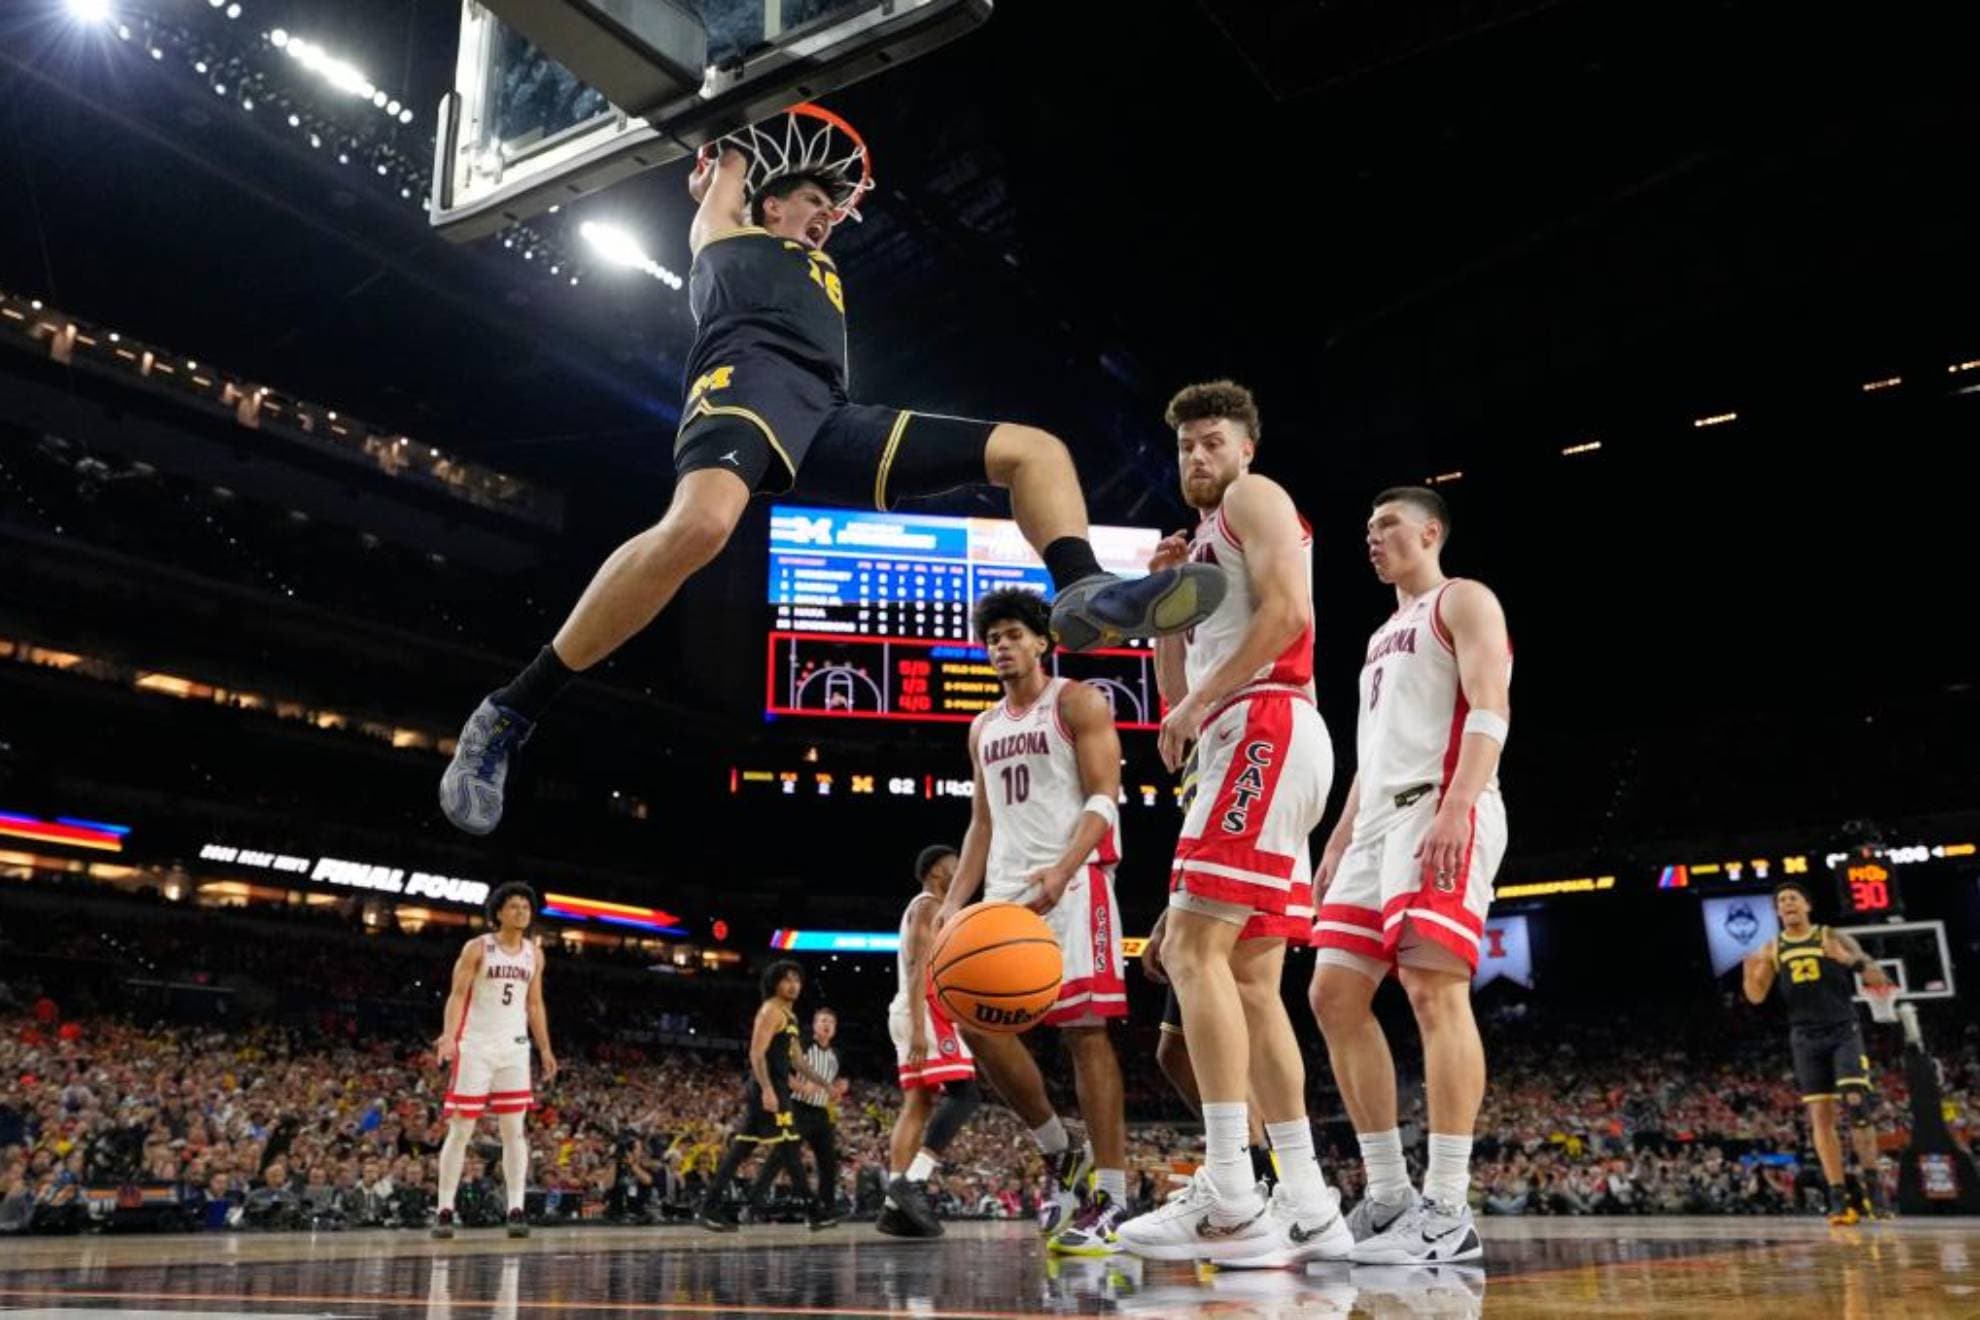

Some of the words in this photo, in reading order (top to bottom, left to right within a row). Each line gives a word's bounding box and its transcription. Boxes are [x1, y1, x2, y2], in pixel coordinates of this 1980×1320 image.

[984, 731, 1050, 765] ARIZONA
[888, 778, 915, 794] 62
[1001, 763, 1030, 805] 10
[1222, 741, 1274, 835] CATS
[310, 857, 404, 893] FINAL
[404, 872, 490, 905] FOUR
[1850, 881, 1888, 909] 30
[1790, 958, 1820, 983] 23
[502, 983, 514, 1006] 5
